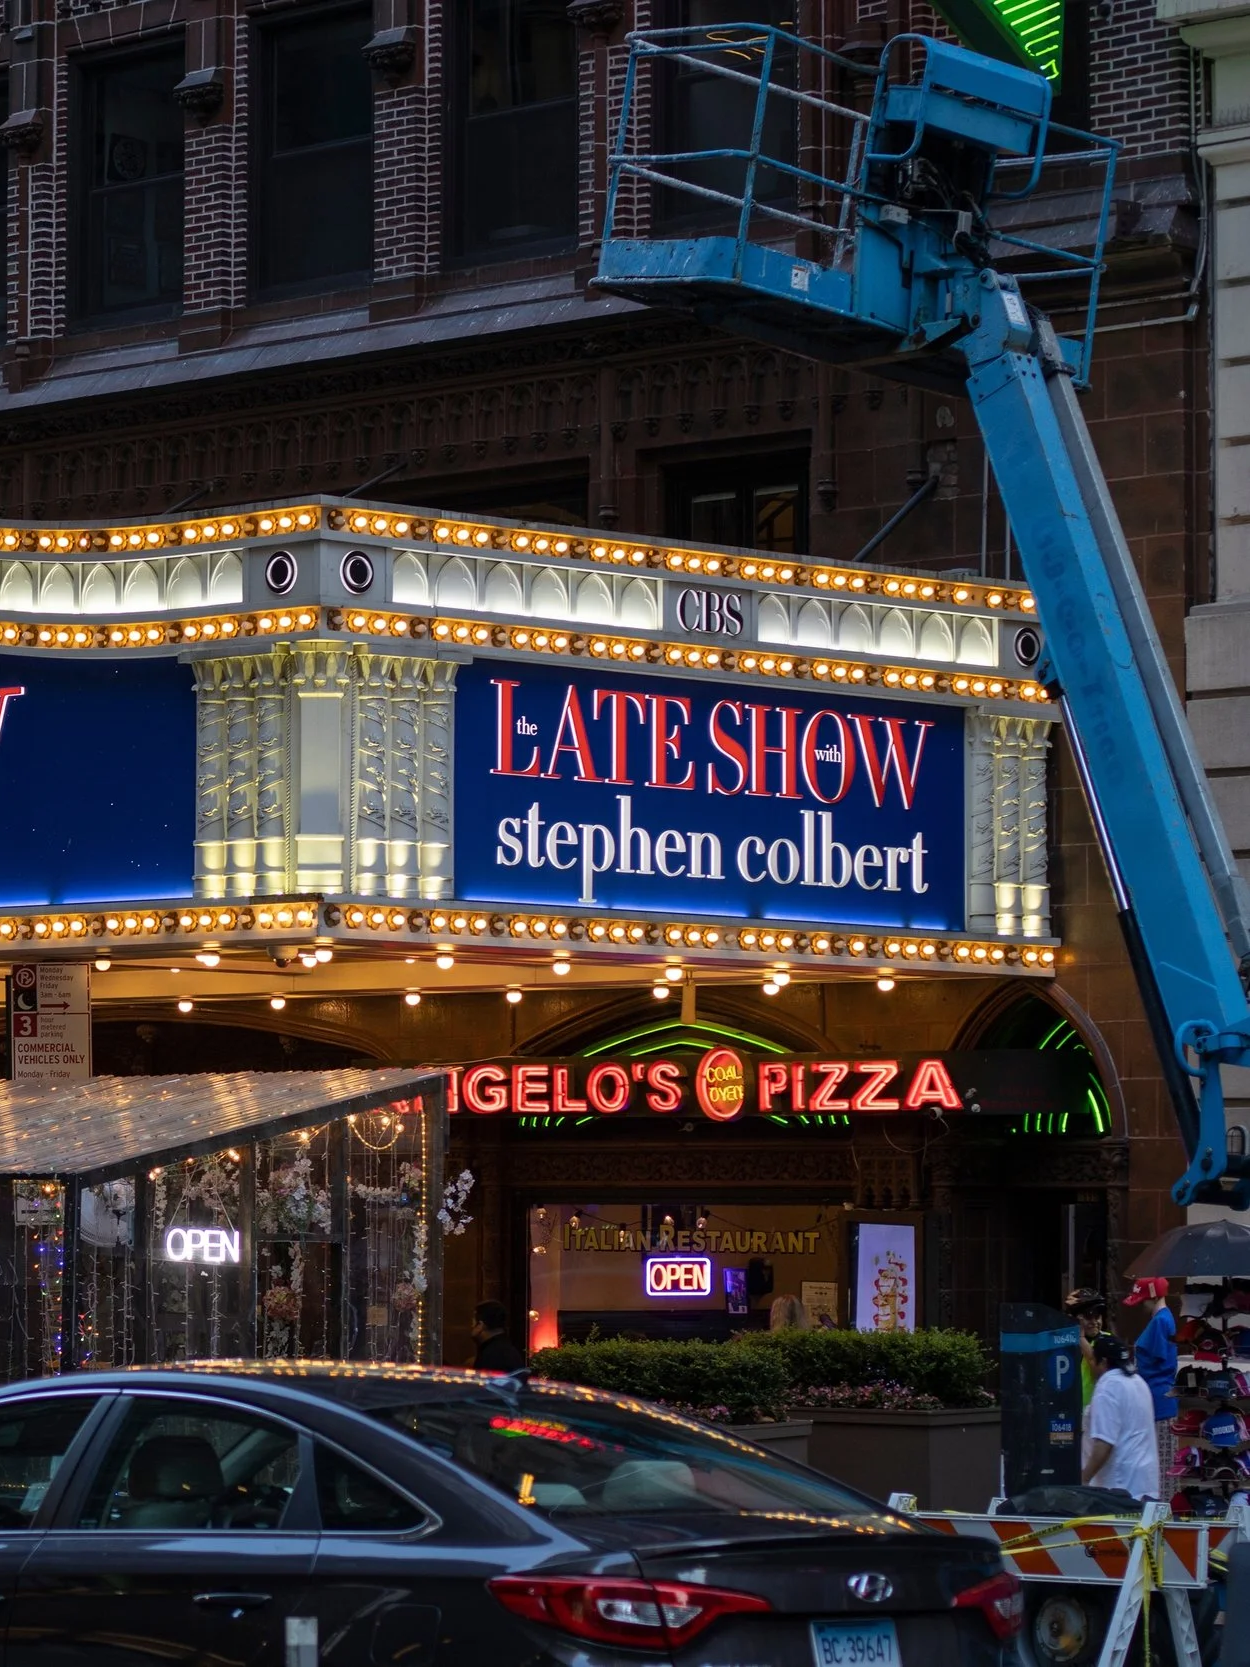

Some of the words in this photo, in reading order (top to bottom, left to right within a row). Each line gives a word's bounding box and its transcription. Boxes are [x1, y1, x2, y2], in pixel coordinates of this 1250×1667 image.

[676, 588, 744, 637] CBS
[489, 678, 696, 791] LATE
[516, 717, 538, 736] the
[707, 699, 936, 811] SHOW
[813, 744, 842, 763] with
[495, 794, 726, 904] stephen
[736, 808, 930, 895] colbert
[39, 966, 63, 975] Monday
[39, 974, 74, 983] Wednesday
[39, 982, 59, 990] Friday
[19, 1015, 32, 1036] 3
[40, 1023, 67, 1031] metered
[40, 1031, 64, 1039] parking
[17, 1043, 76, 1053] COMMERCIAL
[18, 1054, 60, 1065] VEHICLES
[62, 1054, 86, 1064] ONLY
[17, 1069, 44, 1079] Monday
[50, 1069, 71, 1079] Friday
[706, 1065, 742, 1083] COAL
[709, 1085, 744, 1102] OVEN
[758, 1058, 964, 1113] PIZZA
[166, 1227, 240, 1263] OPEN
[563, 1223, 652, 1252] ITALIAN
[659, 1223, 821, 1255] RESTAURANT
[650, 1263, 707, 1291] OPEN
[1055, 1354, 1070, 1389] P
